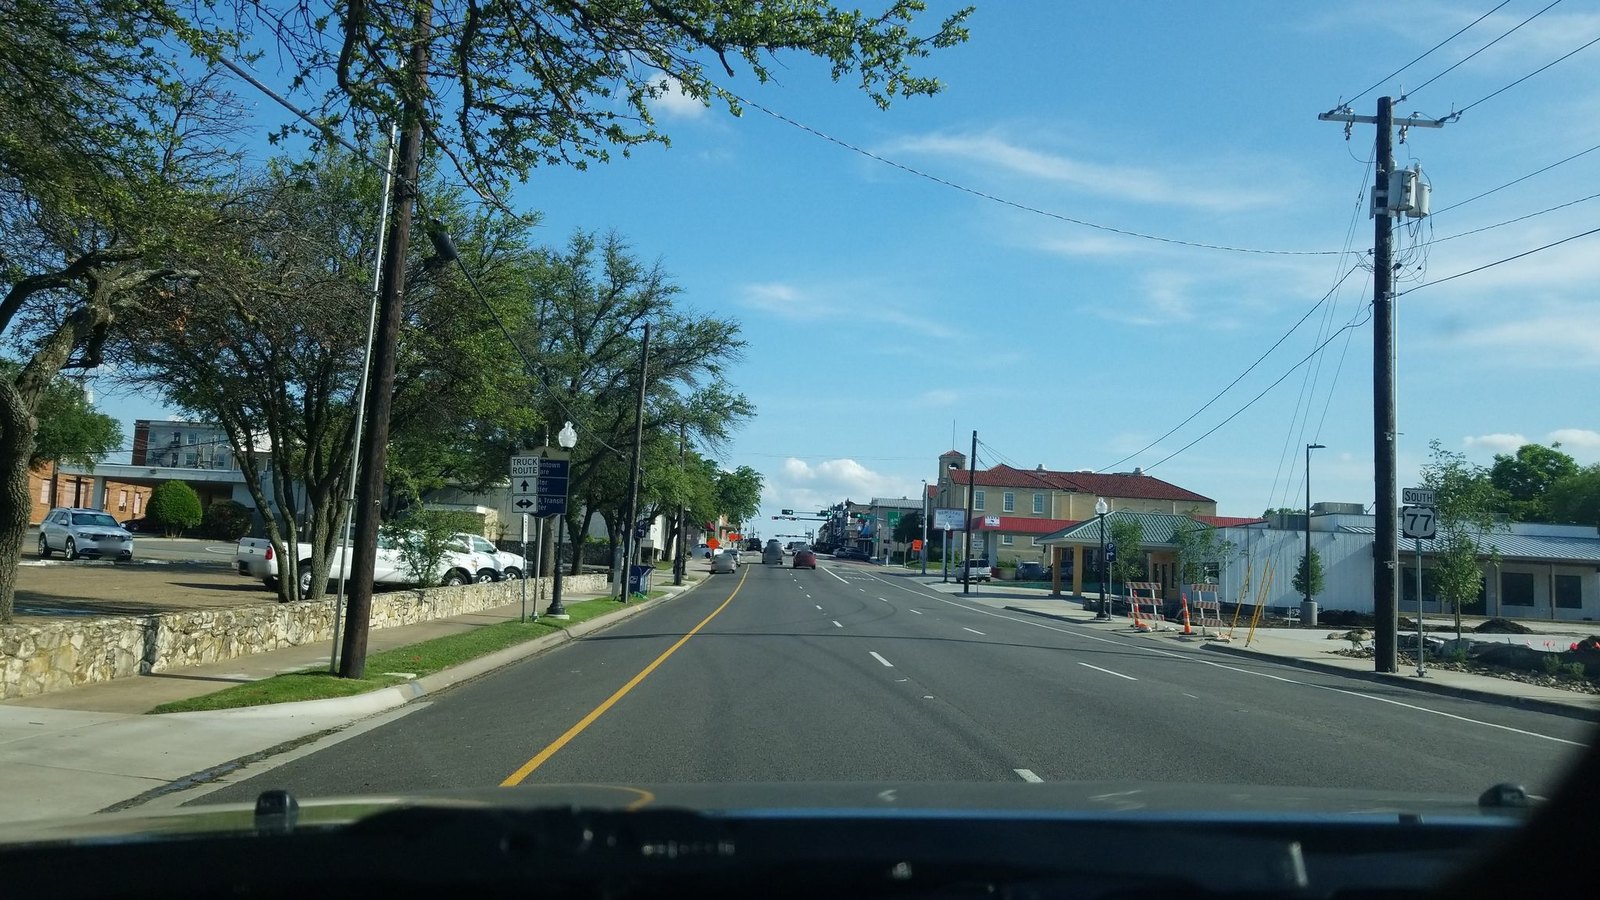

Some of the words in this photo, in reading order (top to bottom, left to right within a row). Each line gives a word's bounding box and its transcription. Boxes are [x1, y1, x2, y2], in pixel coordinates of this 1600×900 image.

[512, 458, 537, 466] TRUCK
[1404, 491, 1433, 502] SOUTH
[1406, 514, 1432, 531] 77
